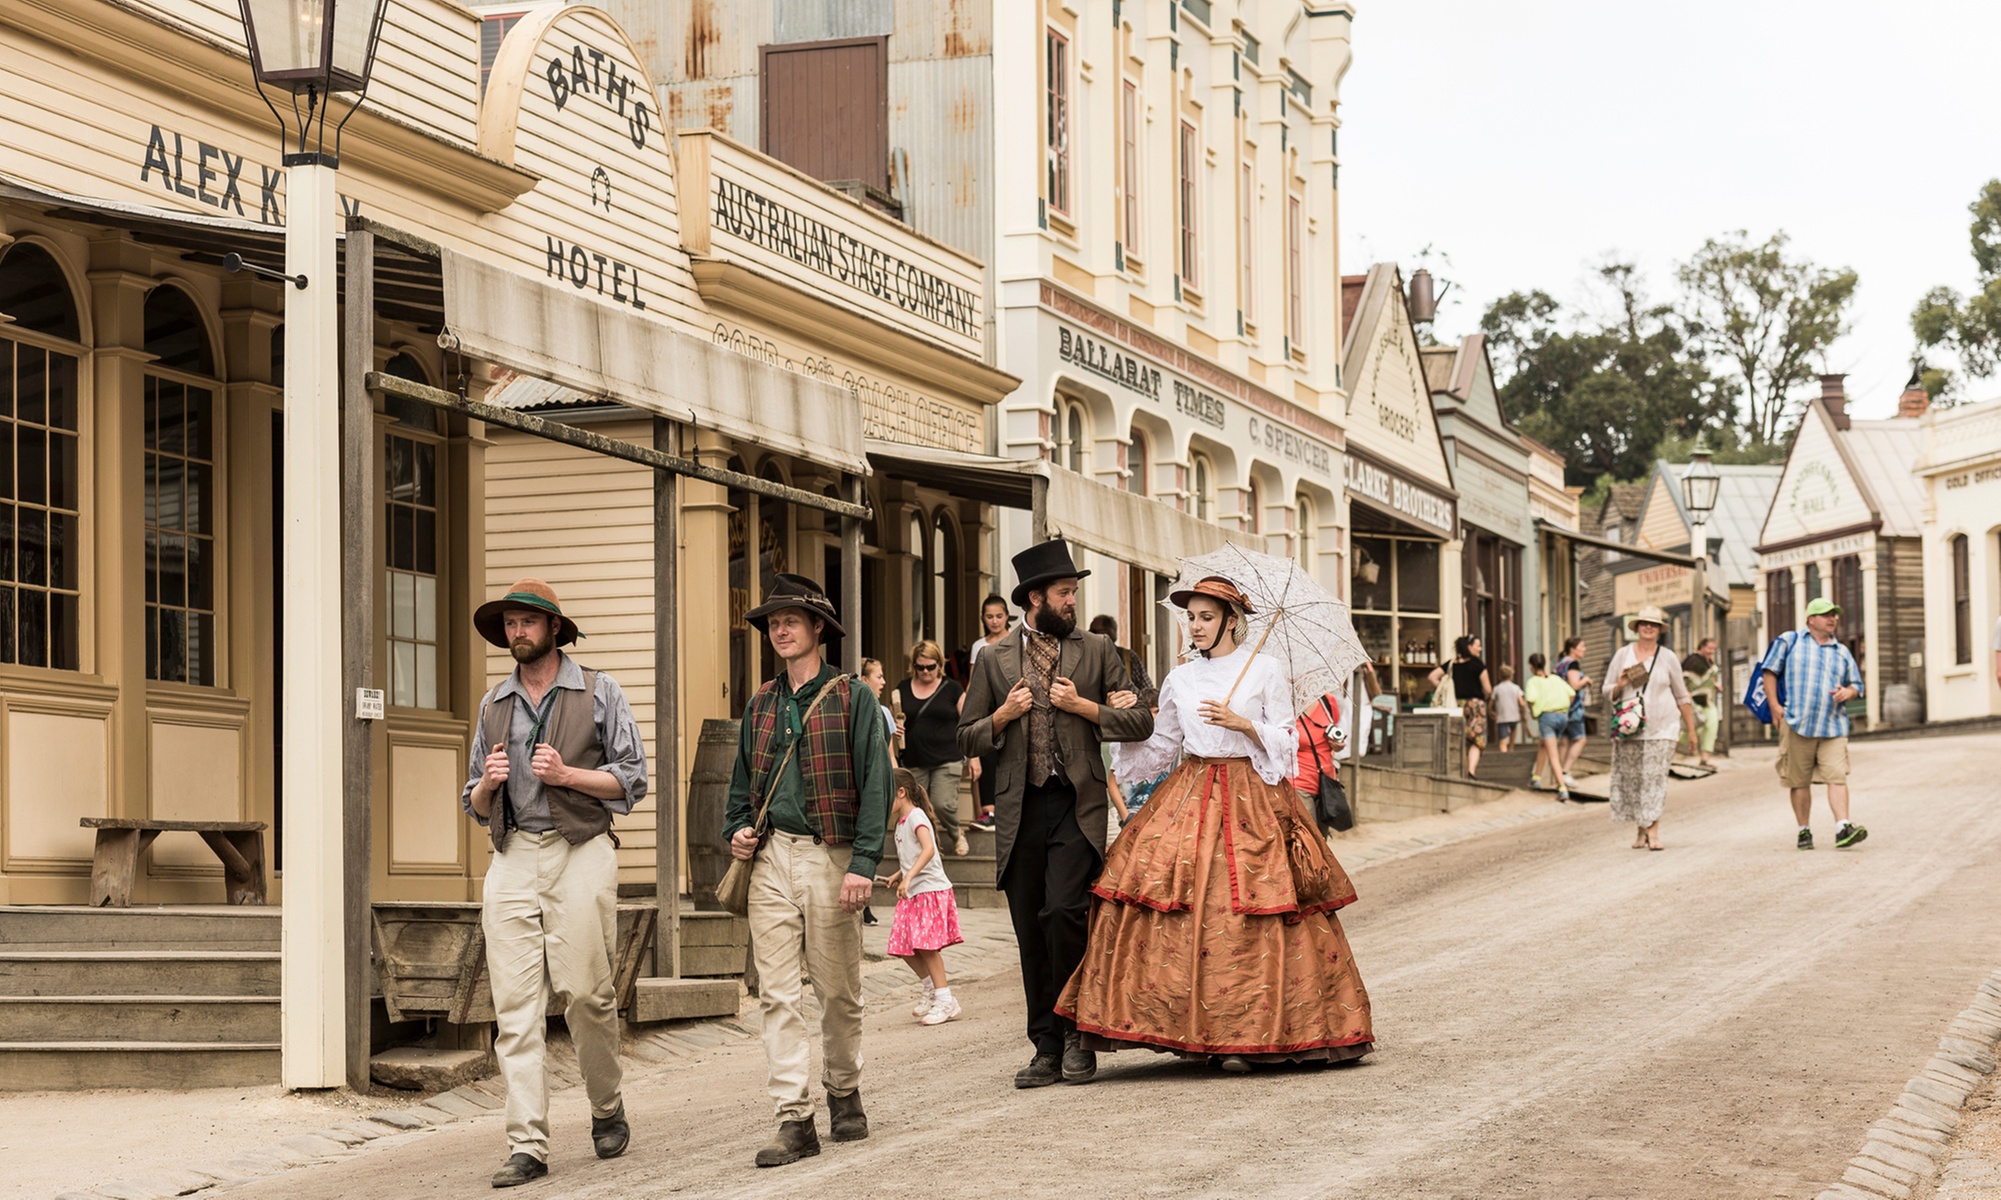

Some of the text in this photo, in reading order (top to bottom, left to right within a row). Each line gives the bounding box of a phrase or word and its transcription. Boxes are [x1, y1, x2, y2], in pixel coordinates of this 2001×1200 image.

[546, 45, 650, 150] BATH'S
[140, 124, 245, 217] ALEX
[547, 236, 646, 311] HOTEL
[716, 177, 833, 275] AUSTRALIAN
[838, 232, 891, 301] STAGE
[1059, 326, 1225, 430] BALLARAT TIMES
[1265, 423, 1330, 475] SPENCER
[1343, 454, 1390, 506] CLARKE
[1392, 478, 1453, 532] BROTHERS
